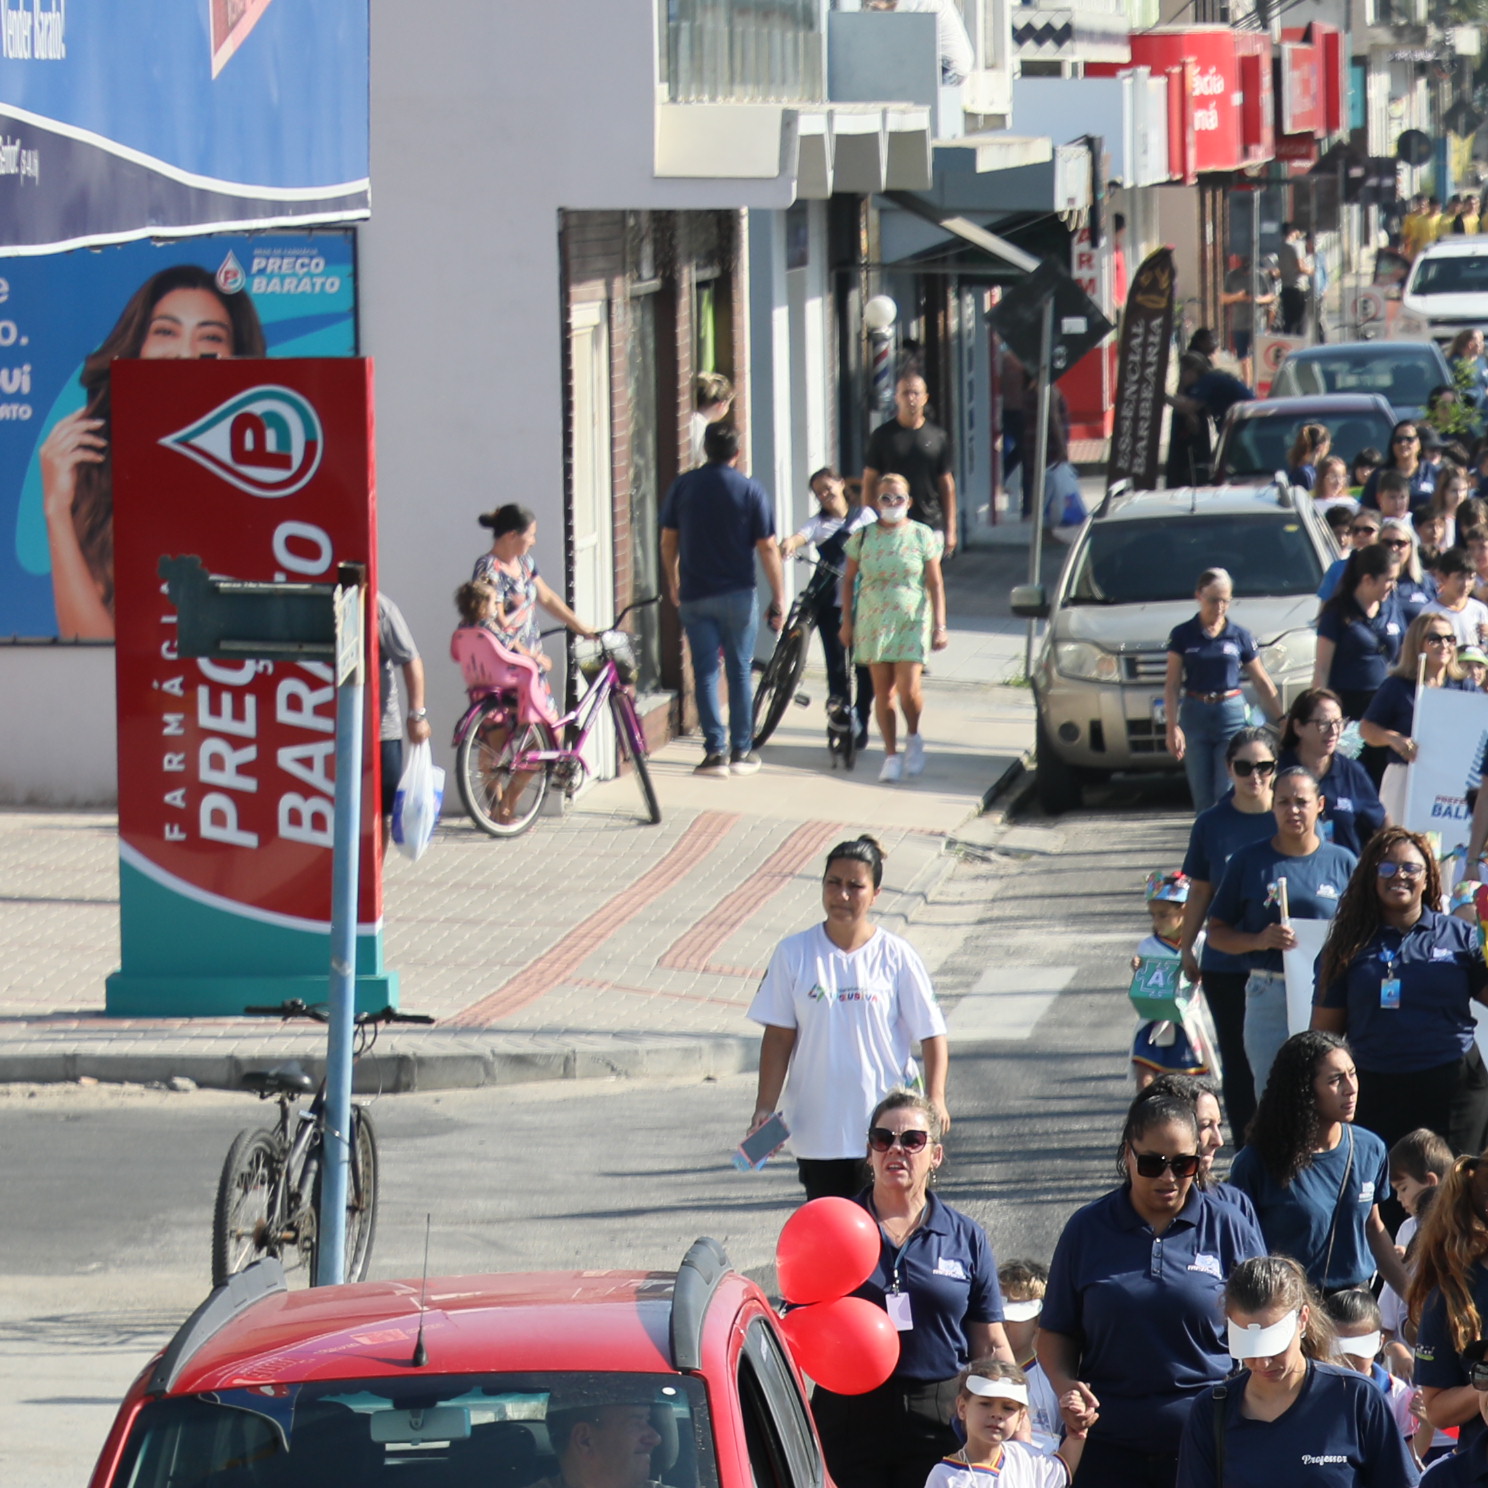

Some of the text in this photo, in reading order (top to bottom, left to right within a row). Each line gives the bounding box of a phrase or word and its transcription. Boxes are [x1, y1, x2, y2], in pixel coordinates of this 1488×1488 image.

[251, 257, 326, 277] PREÇO
[251, 276, 341, 295] BARATO
[1117, 317, 1146, 470] ESSENCIAL
[1131, 316, 1164, 475] BARBEARIA
[1301, 1453, 1348, 1466] Professor
